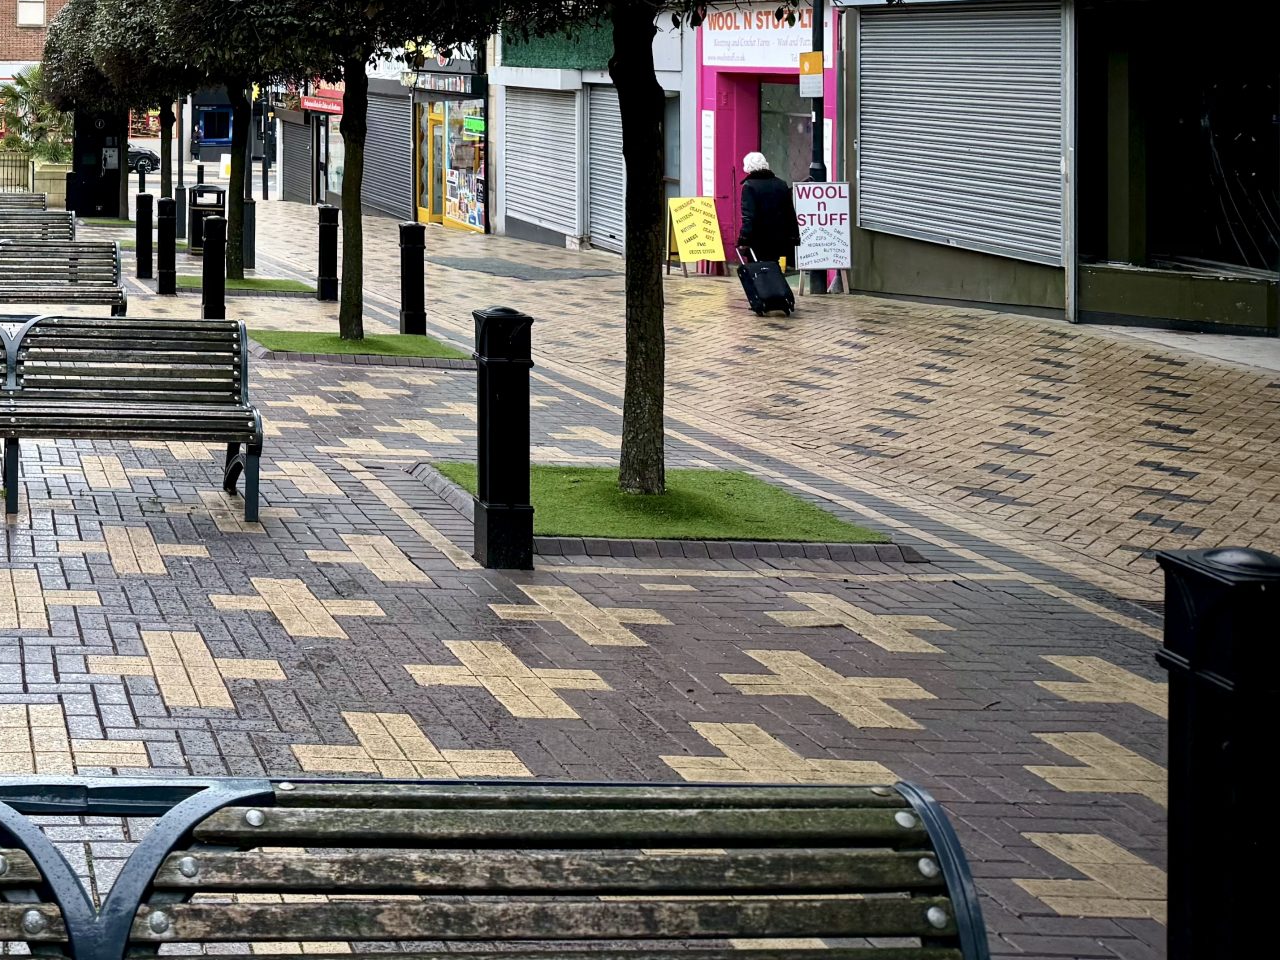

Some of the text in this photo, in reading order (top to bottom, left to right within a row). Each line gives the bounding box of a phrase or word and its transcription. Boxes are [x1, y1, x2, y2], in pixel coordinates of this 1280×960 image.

[708, 12, 740, 30] WOOL
[796, 186, 847, 199] WOOL
[818, 201, 826, 211] n
[797, 213, 848, 226] STUFF
